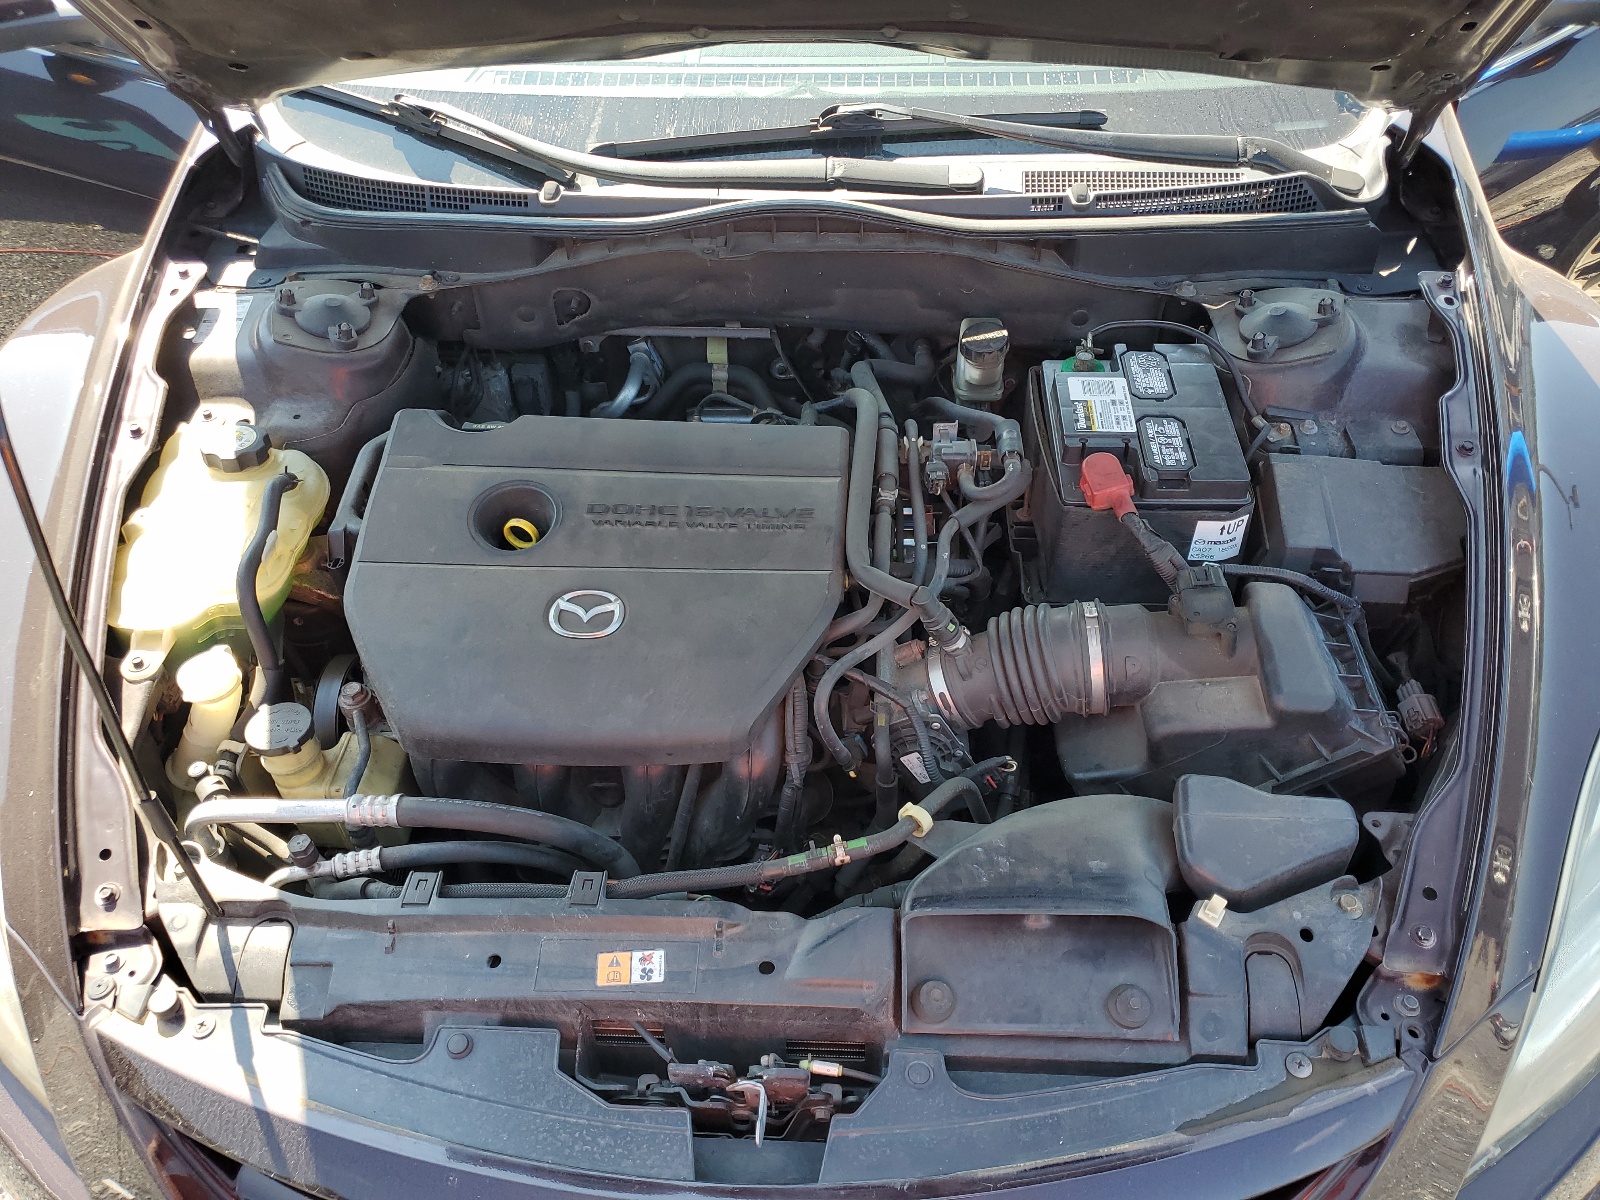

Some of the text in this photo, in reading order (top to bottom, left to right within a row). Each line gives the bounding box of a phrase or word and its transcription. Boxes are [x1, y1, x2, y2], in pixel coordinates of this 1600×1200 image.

[586, 503, 679, 516] DOHC
[592, 518, 680, 529] VARIABLE
[686, 520, 738, 530] VALVE
[1227, 519, 1244, 535] UP
